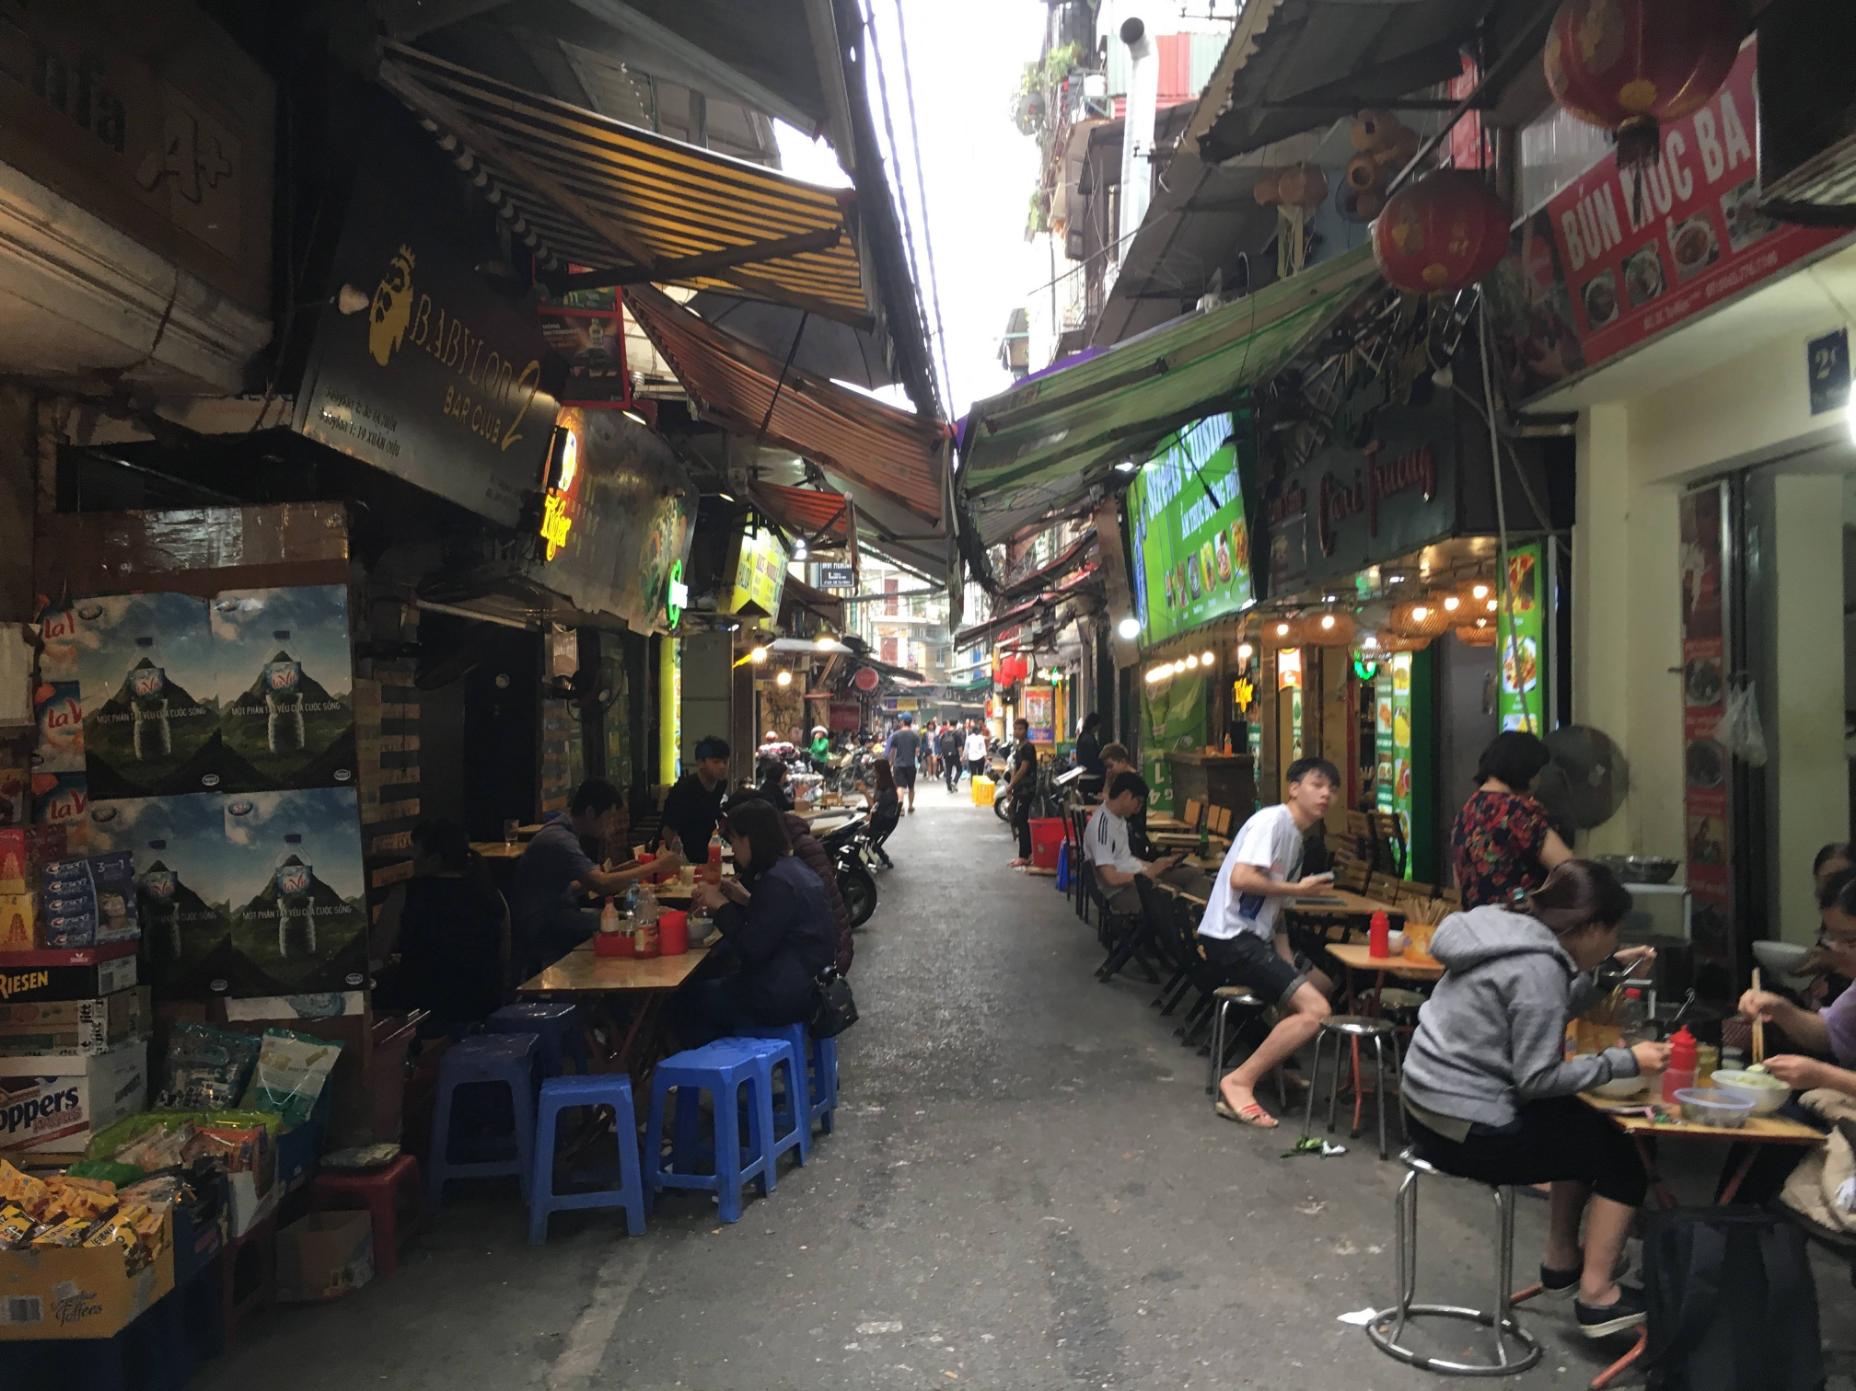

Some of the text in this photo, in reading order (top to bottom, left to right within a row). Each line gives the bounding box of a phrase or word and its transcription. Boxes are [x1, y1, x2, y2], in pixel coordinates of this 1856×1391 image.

[1560, 183, 1622, 272] BÚN
[1692, 90, 1752, 184] BA
[443, 385, 502, 444] BAR CLUB
[502, 359, 541, 452] 2
[0, 969, 49, 999] RIESEN
